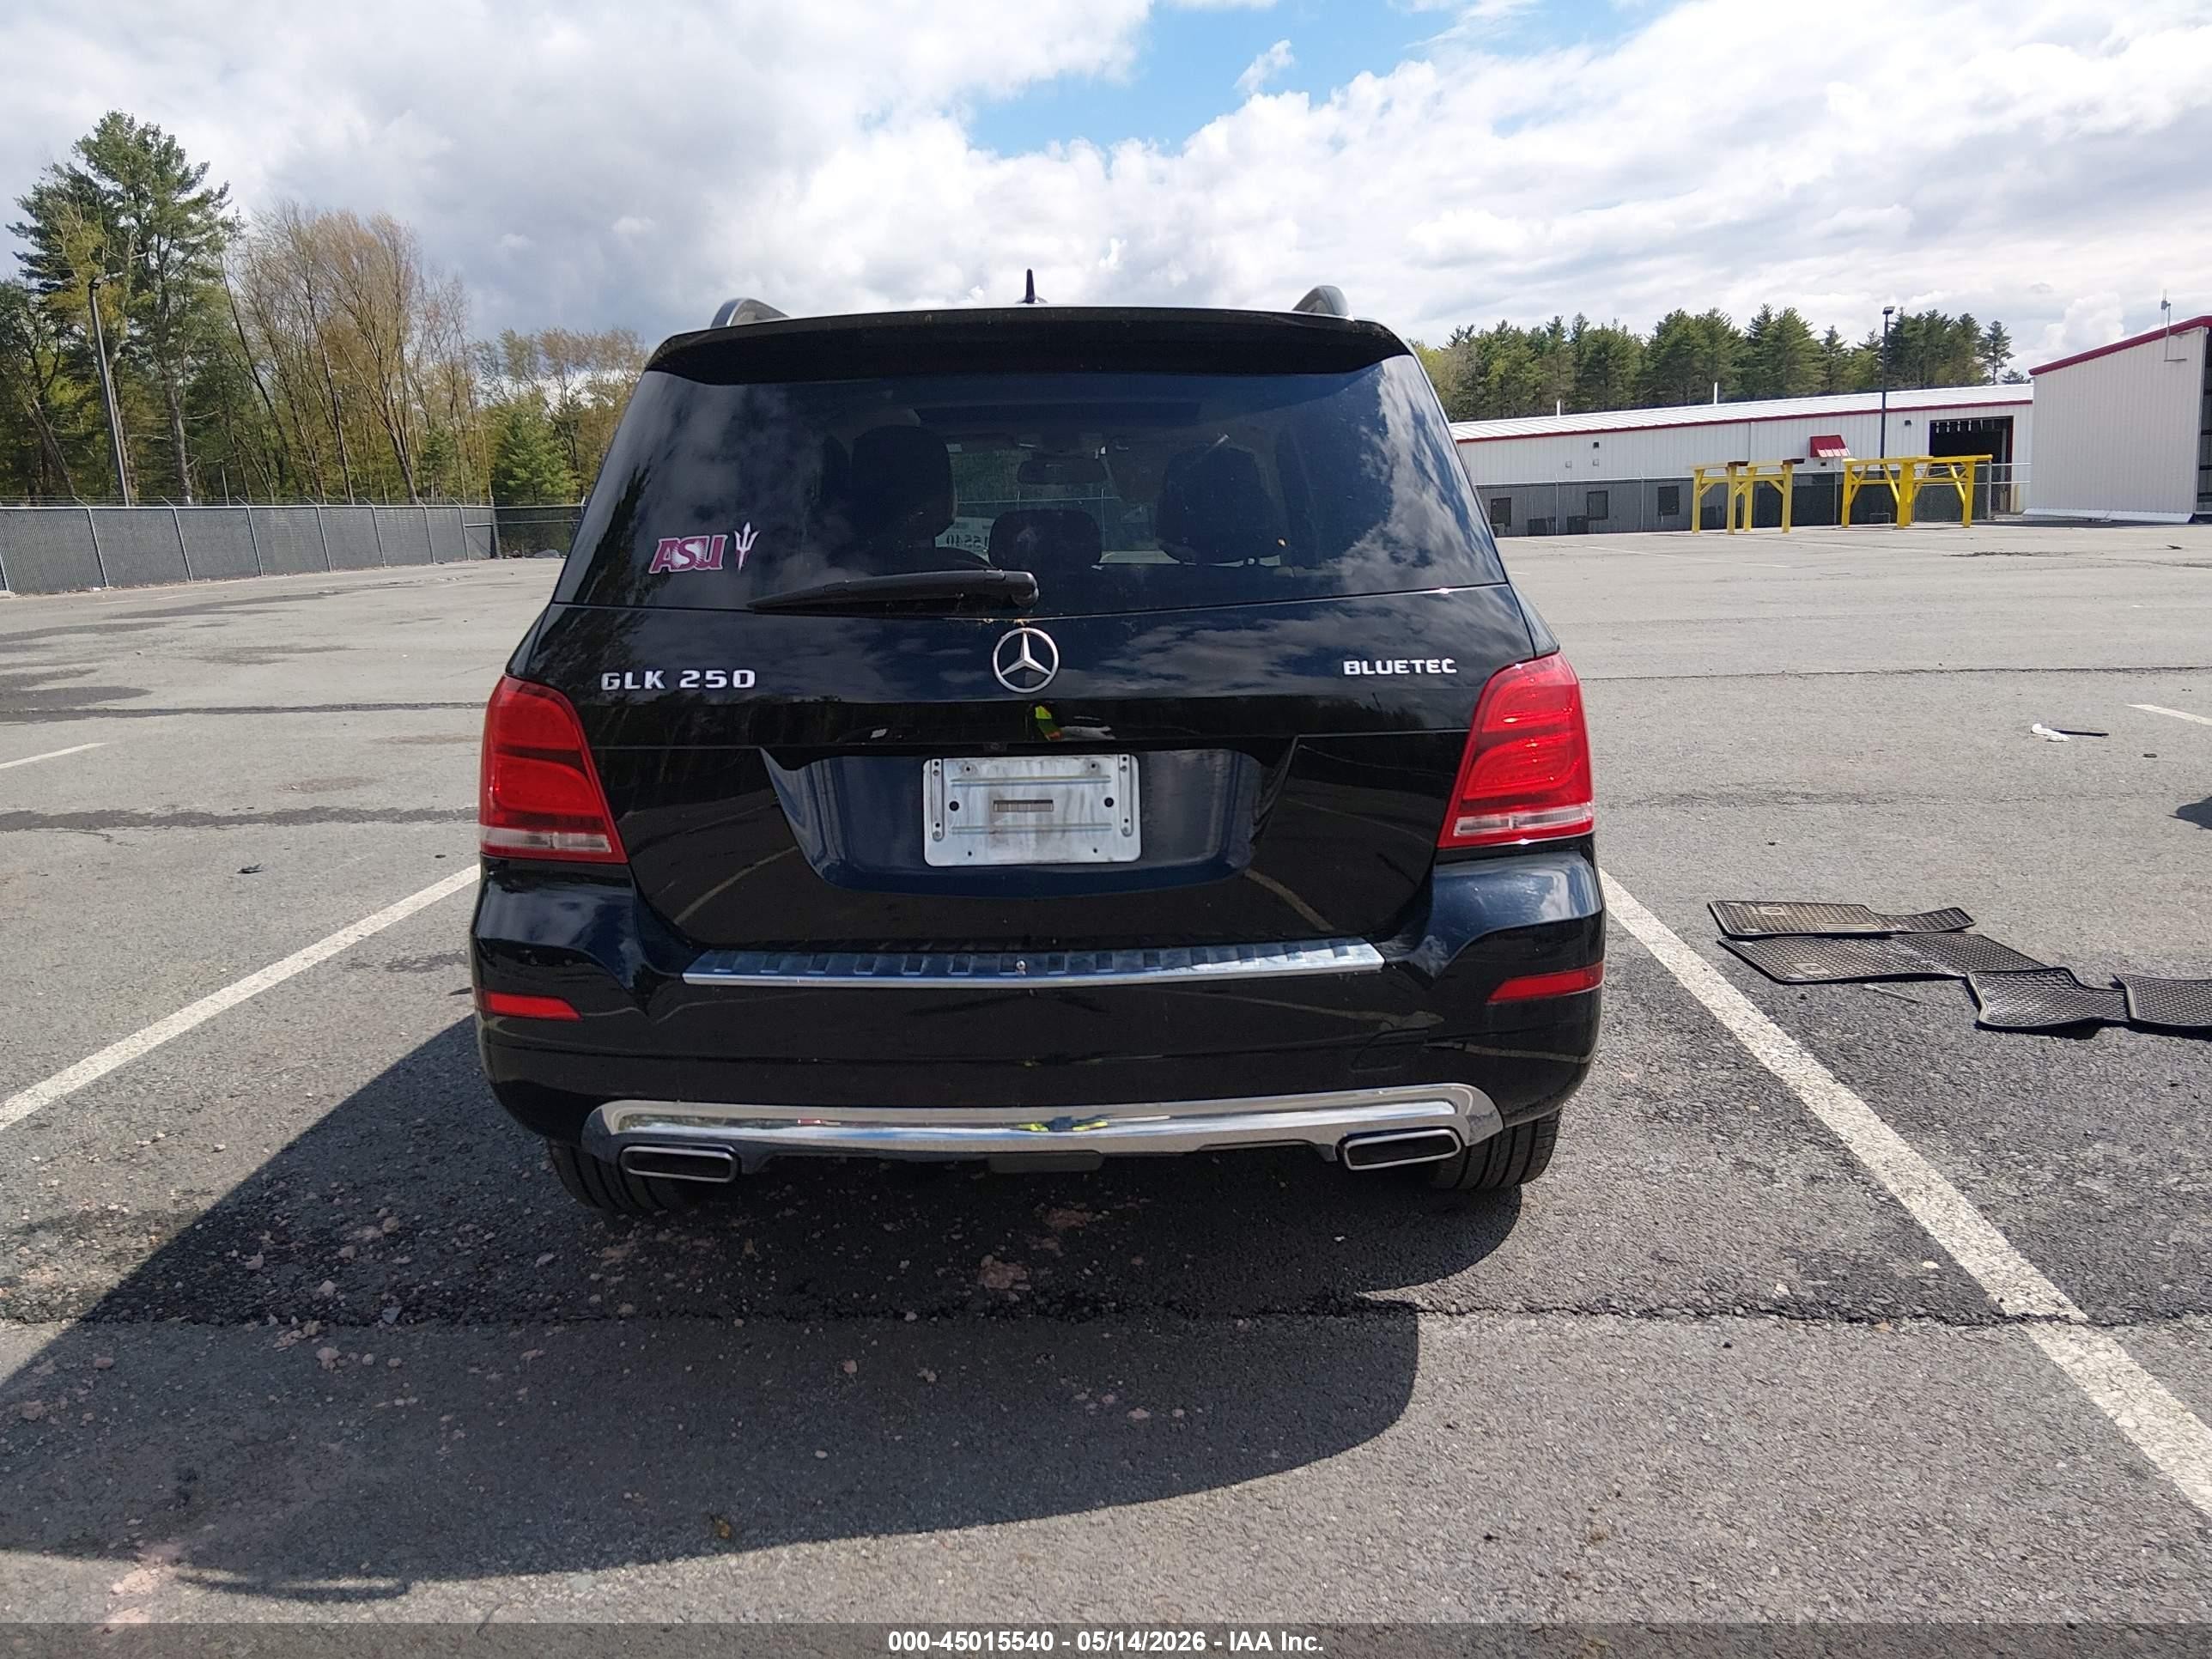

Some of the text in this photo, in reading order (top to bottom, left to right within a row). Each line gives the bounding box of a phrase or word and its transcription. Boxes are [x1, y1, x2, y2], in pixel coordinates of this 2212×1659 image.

[648, 535, 728, 574] ASU
[1343, 658, 1457, 675] BLUETEC
[601, 669, 756, 690] GLK 250
